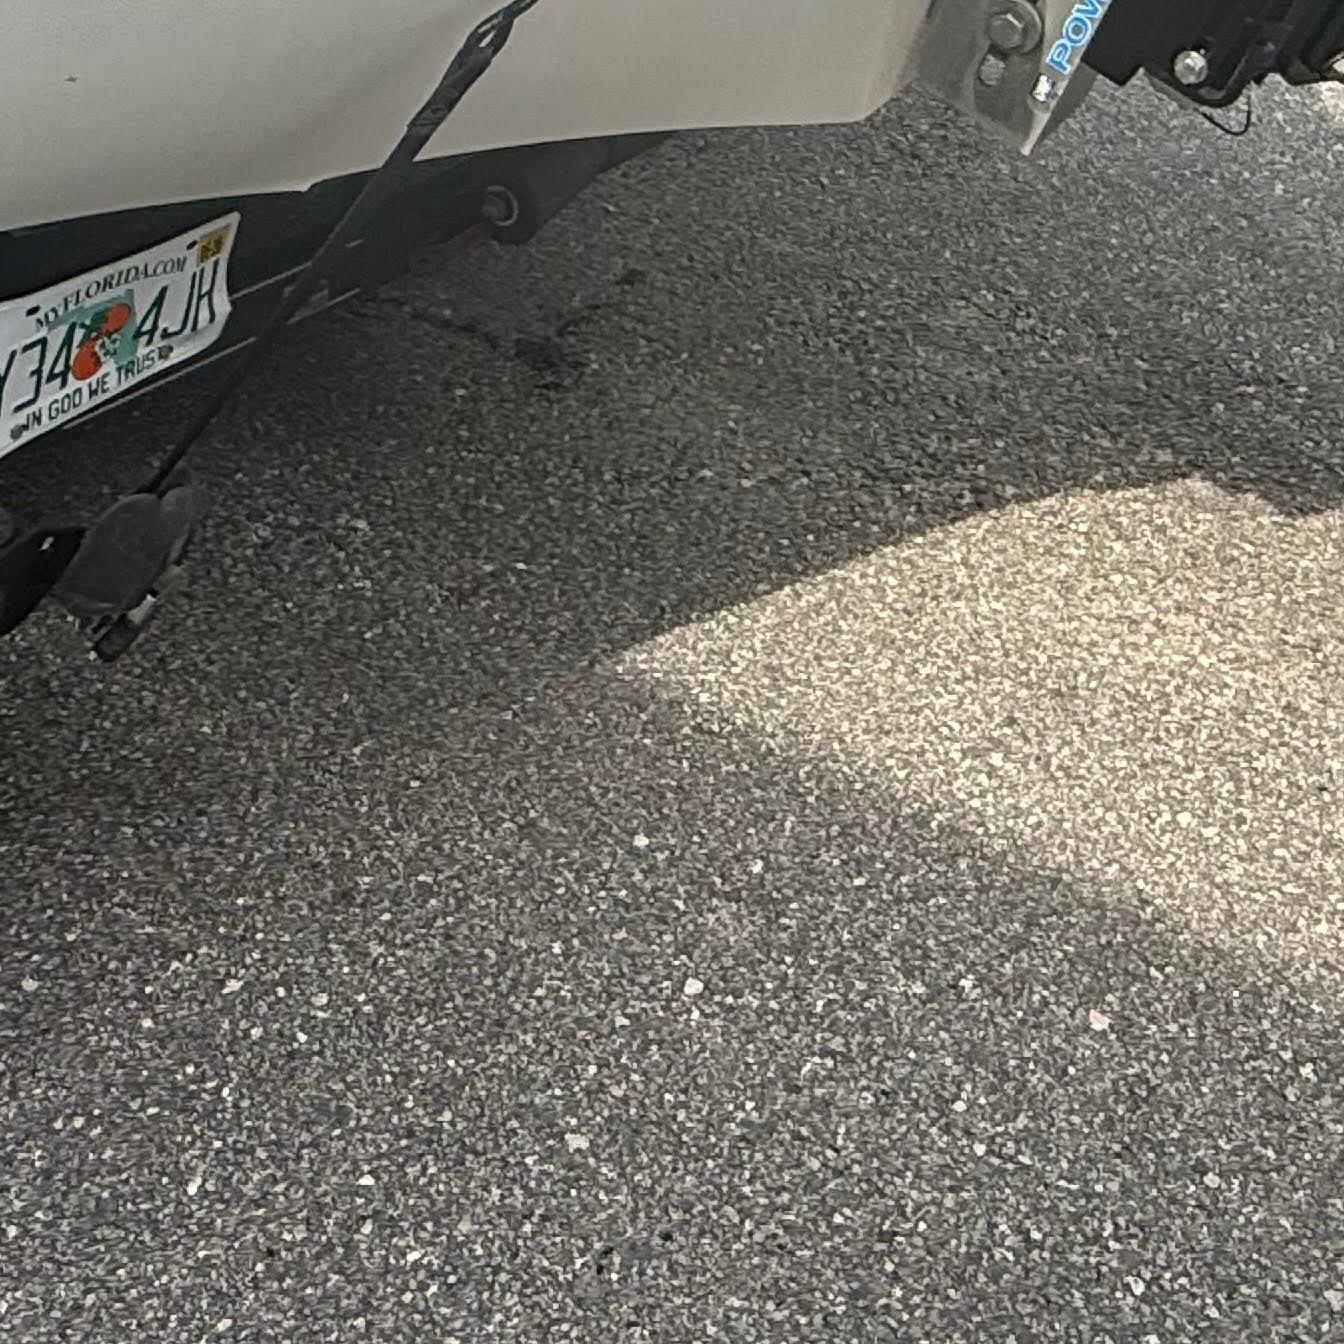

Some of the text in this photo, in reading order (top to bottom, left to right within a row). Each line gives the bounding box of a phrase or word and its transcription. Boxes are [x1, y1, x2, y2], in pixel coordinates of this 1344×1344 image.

[34, 256, 188, 330] MYFLORIDA.COM
[132, 256, 220, 347] 4JH
[48, 386, 83, 422] GOD
[88, 373, 110, 396] WE
